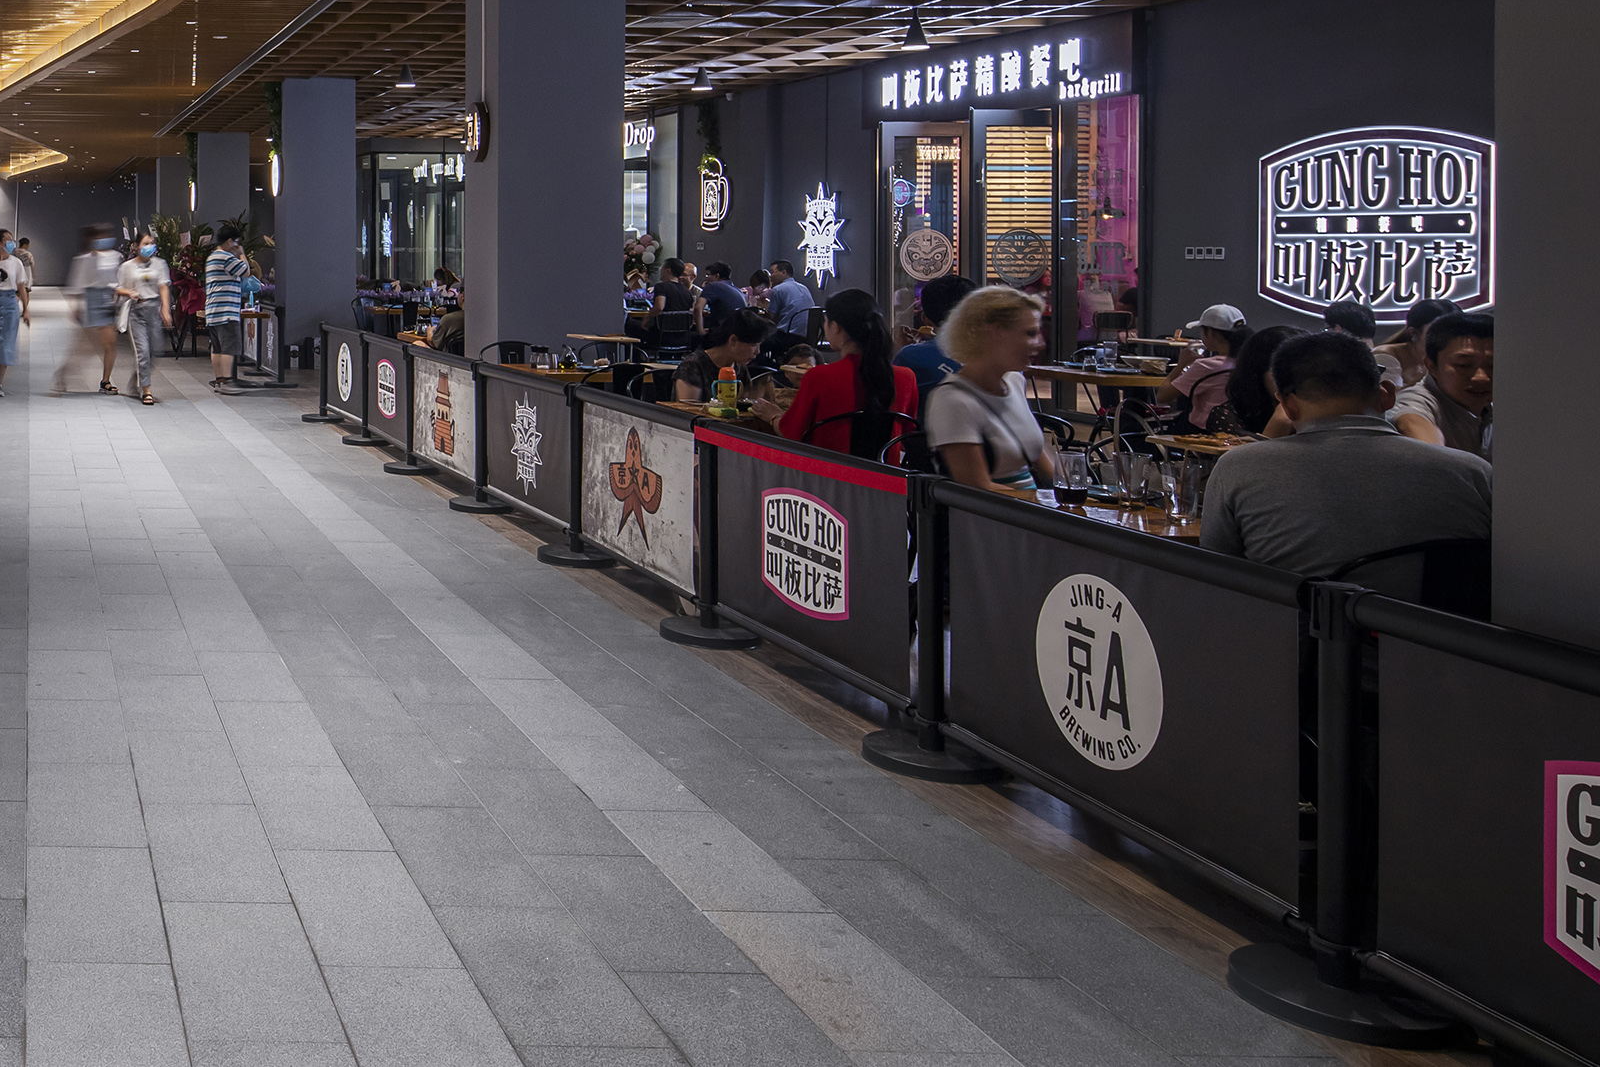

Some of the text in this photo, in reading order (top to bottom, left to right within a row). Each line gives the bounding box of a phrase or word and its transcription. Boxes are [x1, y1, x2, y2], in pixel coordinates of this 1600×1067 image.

[1273, 144, 1477, 211] GUNG HO!
[1272, 239, 1477, 305] 叫板比萨
[766, 499, 842, 555] GUNG HO!
[766, 549, 843, 610] 叫板比萨
[1070, 584, 1123, 623] JING-A
[1059, 705, 1142, 762] BREWING CO.
